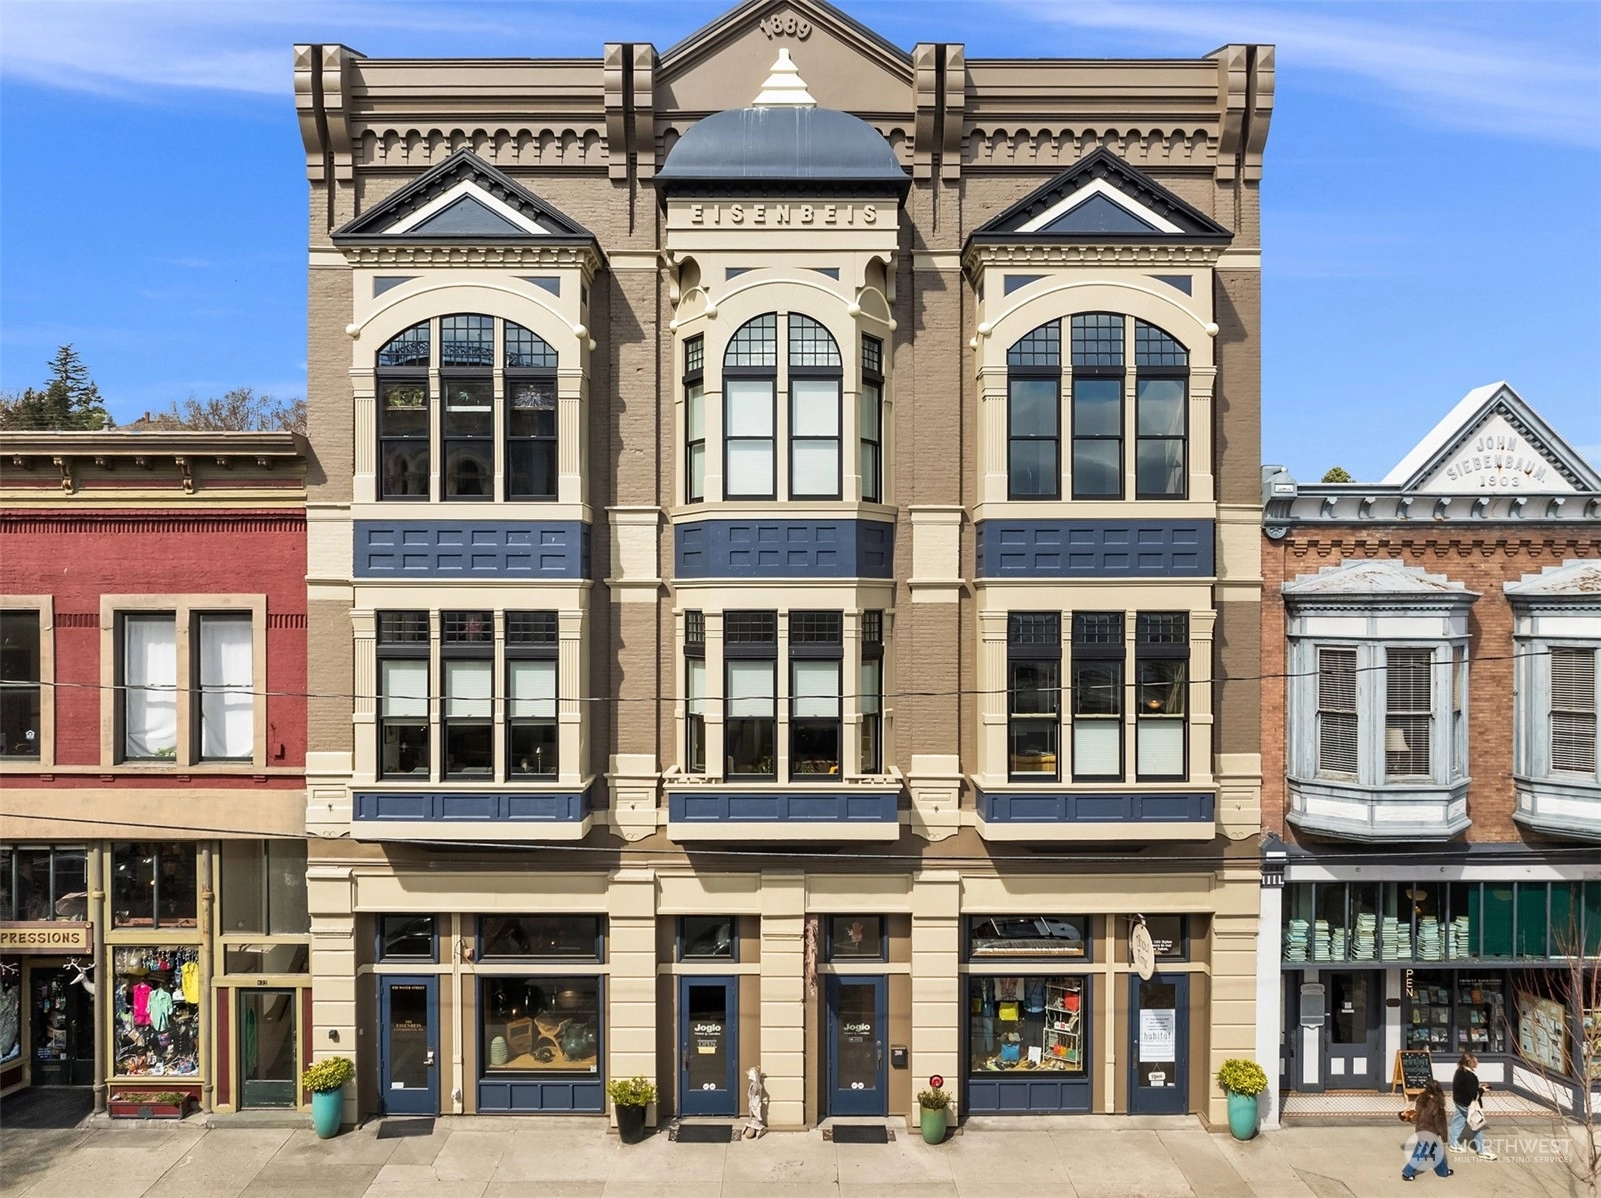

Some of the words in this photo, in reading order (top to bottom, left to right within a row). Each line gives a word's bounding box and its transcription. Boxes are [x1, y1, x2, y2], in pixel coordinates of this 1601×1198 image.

[758, 14, 812, 40] 1889
[690, 204, 878, 224] EISENBEIS
[1476, 436, 1517, 452] JOHN
[1479, 476, 1519, 487] 1903
[0, 932, 80, 944] PRESSIONS
[1144, 1032, 1171, 1040] habitat
